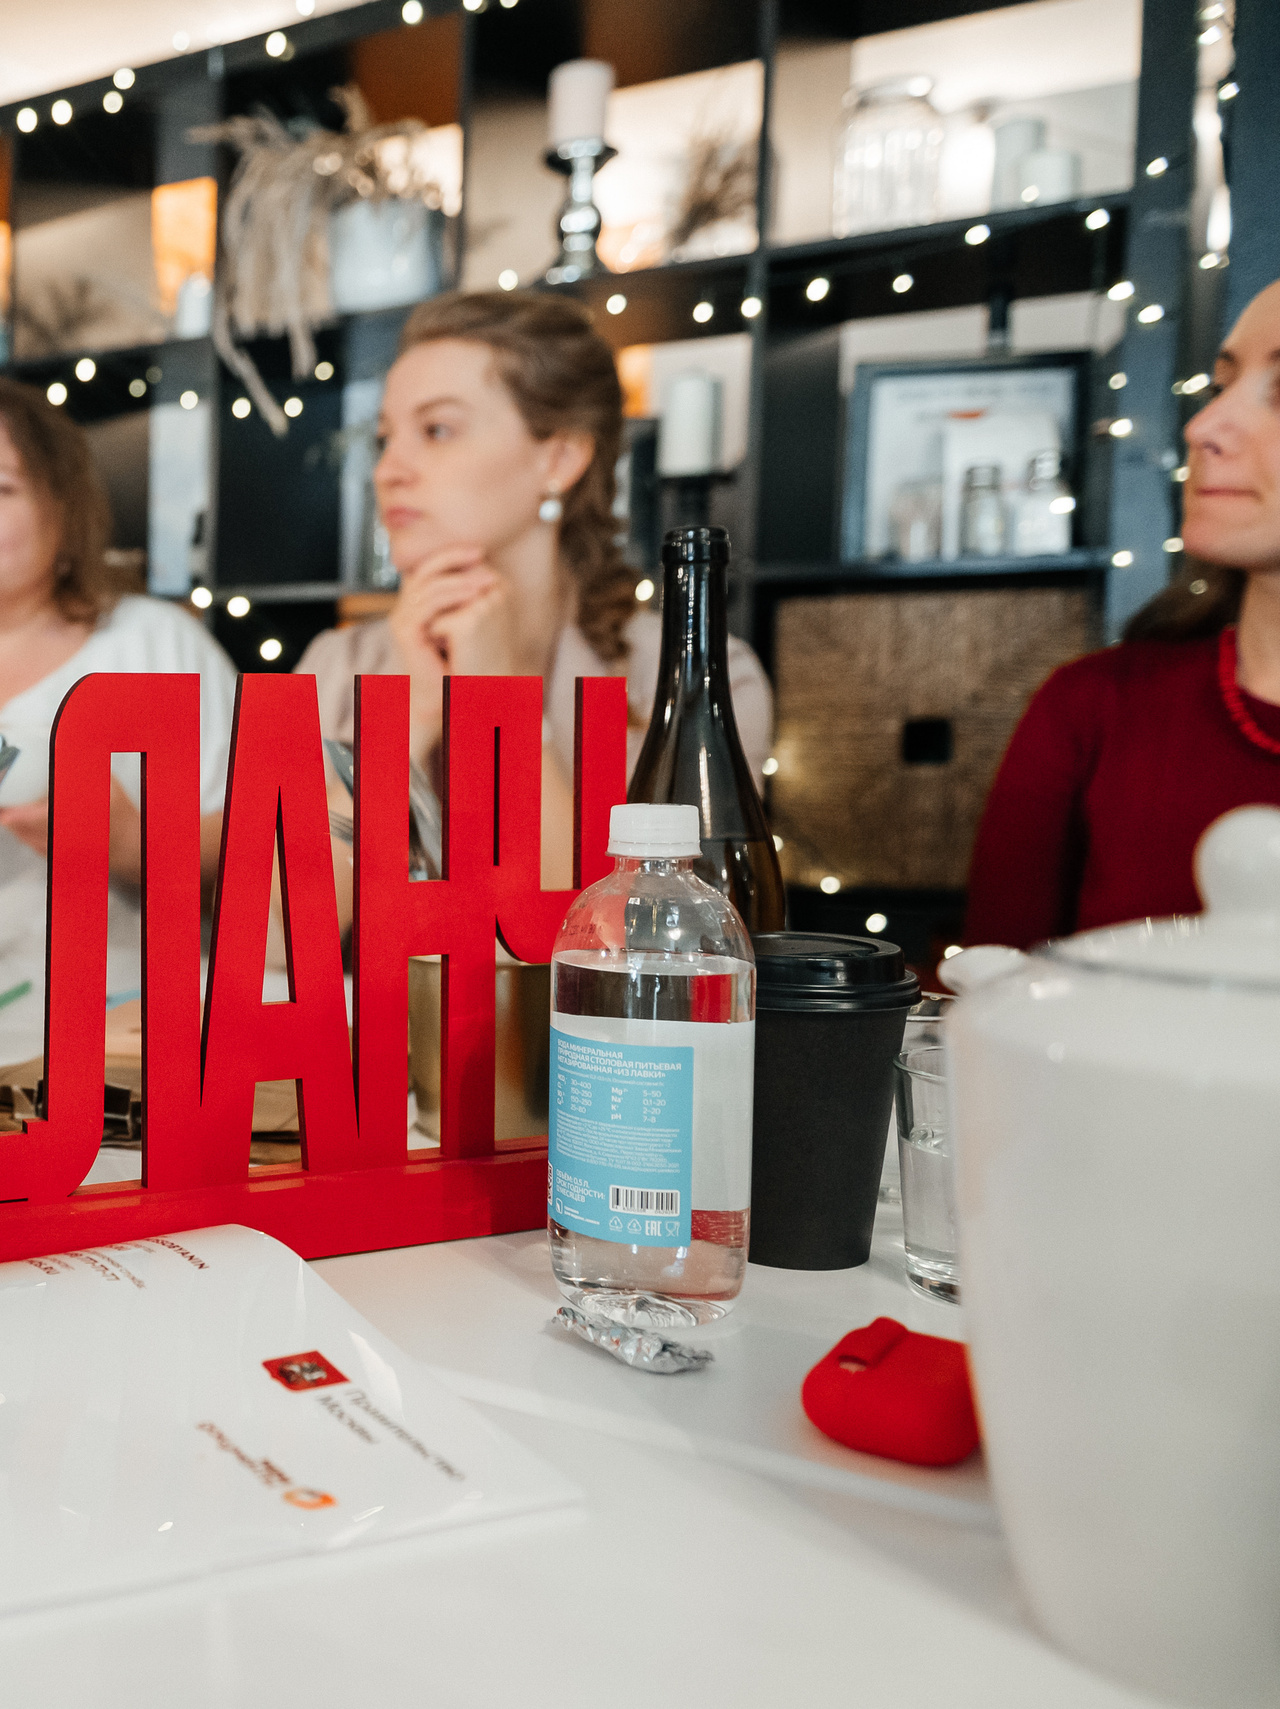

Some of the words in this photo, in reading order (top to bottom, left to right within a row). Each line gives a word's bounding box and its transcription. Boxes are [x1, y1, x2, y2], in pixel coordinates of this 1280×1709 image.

[557, 1046, 589, 1062] ПРИРОДНАЯ
[590, 1056, 633, 1068] СТОЛОВАЯ
[635, 1062, 682, 1071] ПИТЬЕВАЯ
[570, 1042, 623, 1060] МИНЕРАЛЬНАЯ
[557, 1054, 612, 1074] НЕГАЗИРОВАННАЯ
[613, 1068, 629, 1076] «ИЗ
[631, 1070, 666, 1078] ЛАВКИ»
[611, 1113, 622, 1121] pH
[560, 1187, 586, 1202] МЕСЯЦЕВ
[567, 1182, 606, 1200] ГОДНОСТИ:
